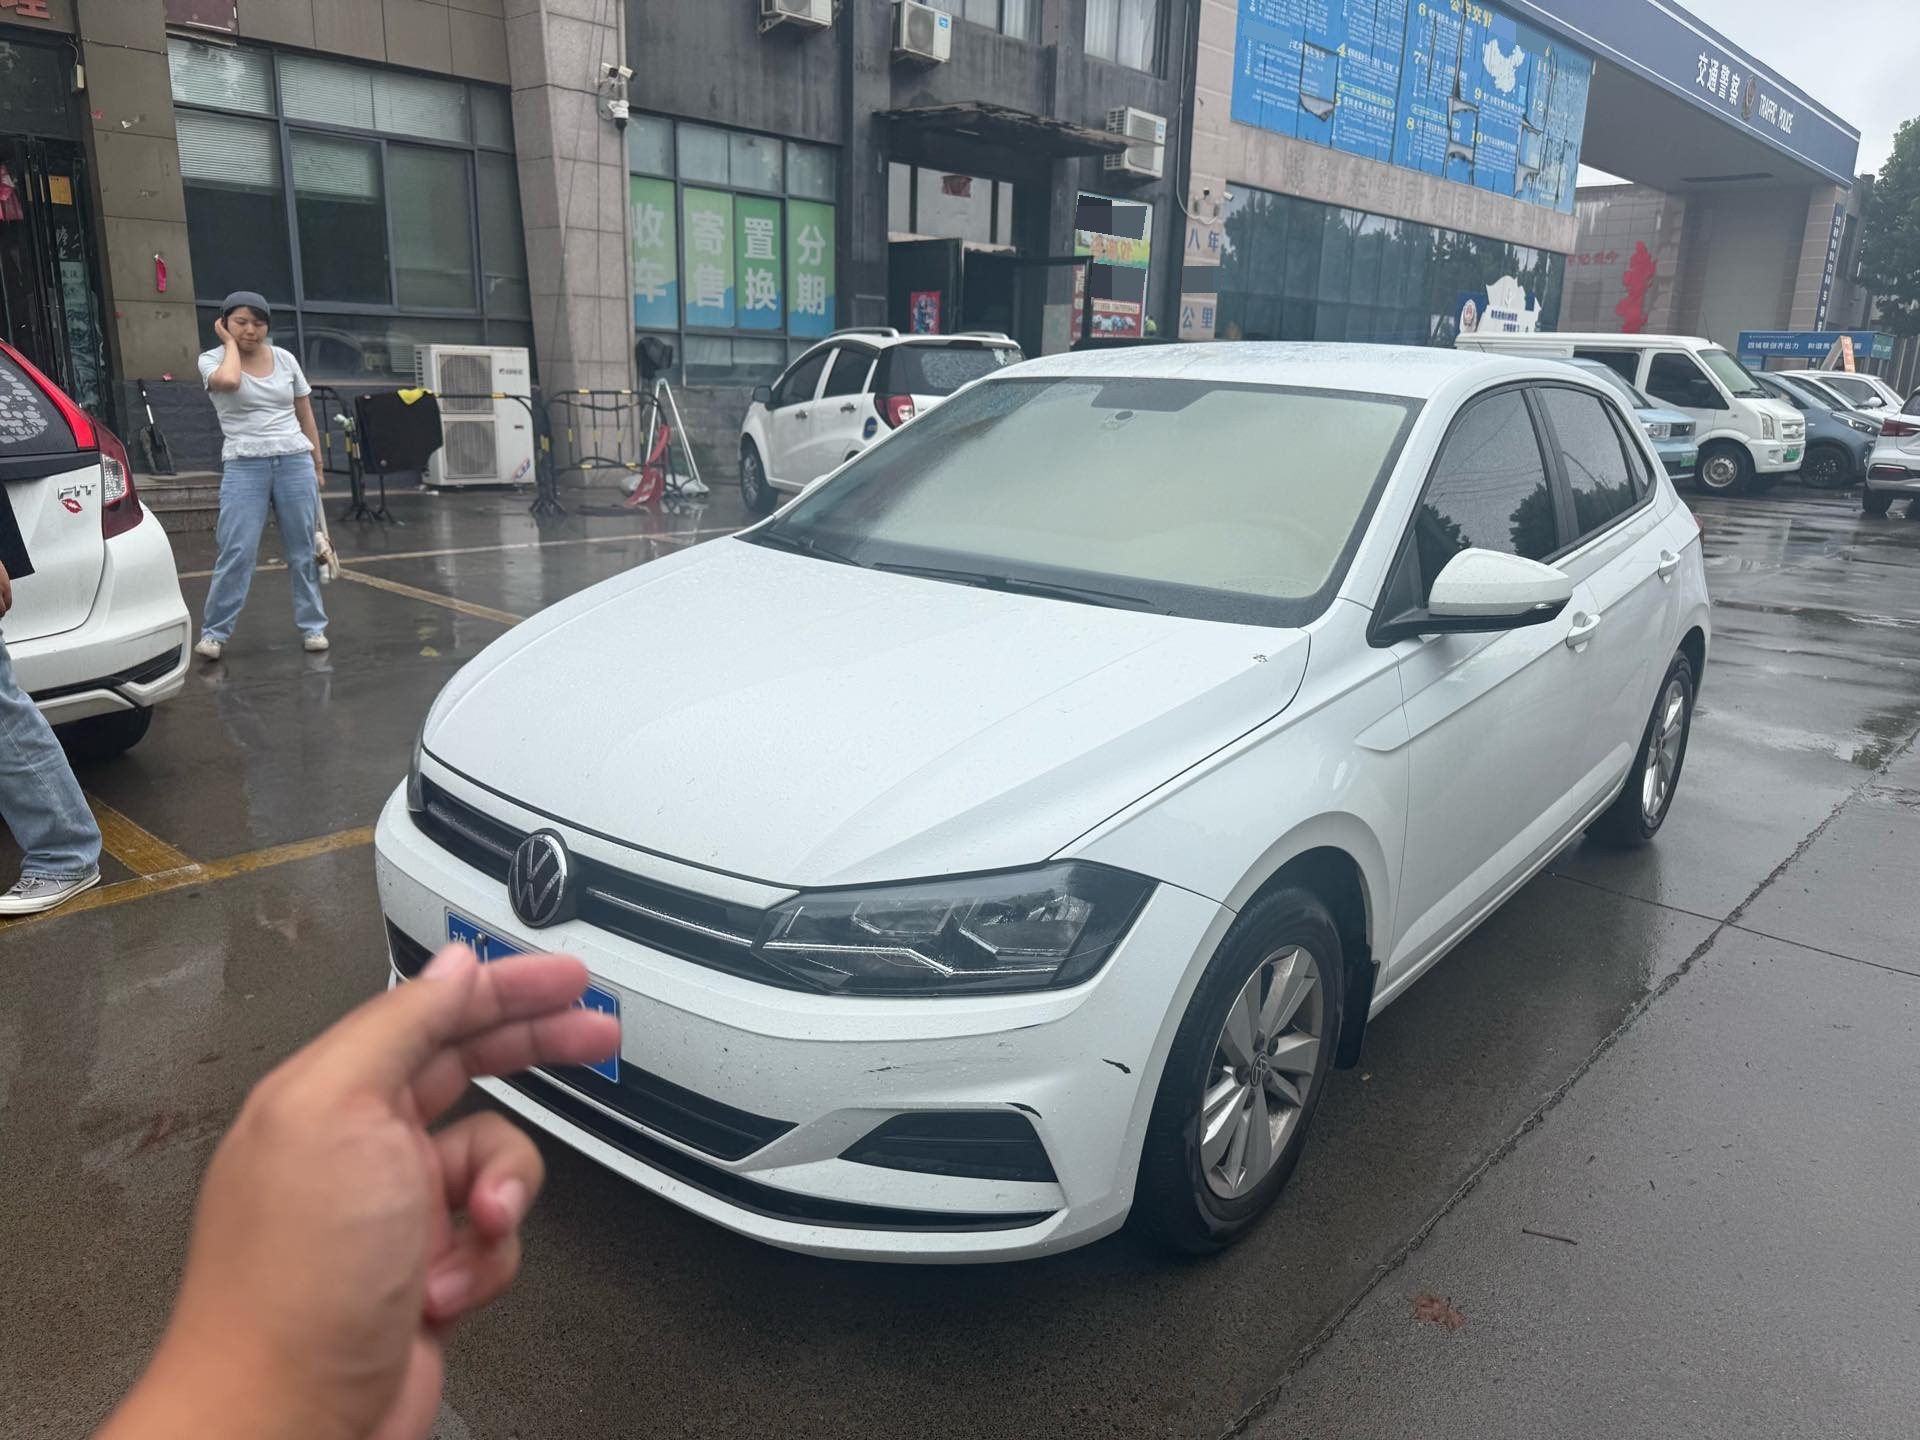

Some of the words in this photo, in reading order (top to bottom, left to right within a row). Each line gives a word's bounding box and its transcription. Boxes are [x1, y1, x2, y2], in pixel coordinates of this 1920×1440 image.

[1418, 3, 1427, 17] 6
[1337, 43, 1346, 58] 4
[1413, 51, 1423, 65] 7
[1696, 51, 1740, 106] 交通警察
[1474, 87, 1482, 100] 9
[1406, 117, 1415, 130] 8
[1758, 94, 1778, 125] TRAFFIC
[1777, 107, 1794, 134] POLICE
[1188, 228, 1220, 251] 八年
[631, 203, 667, 303] 收车
[691, 211, 725, 309] 寄售
[744, 217, 776, 311] 置换
[797, 225, 826, 315] 分期
[1182, 306, 1214, 329] 公里
[57, 483, 97, 501] FIT
